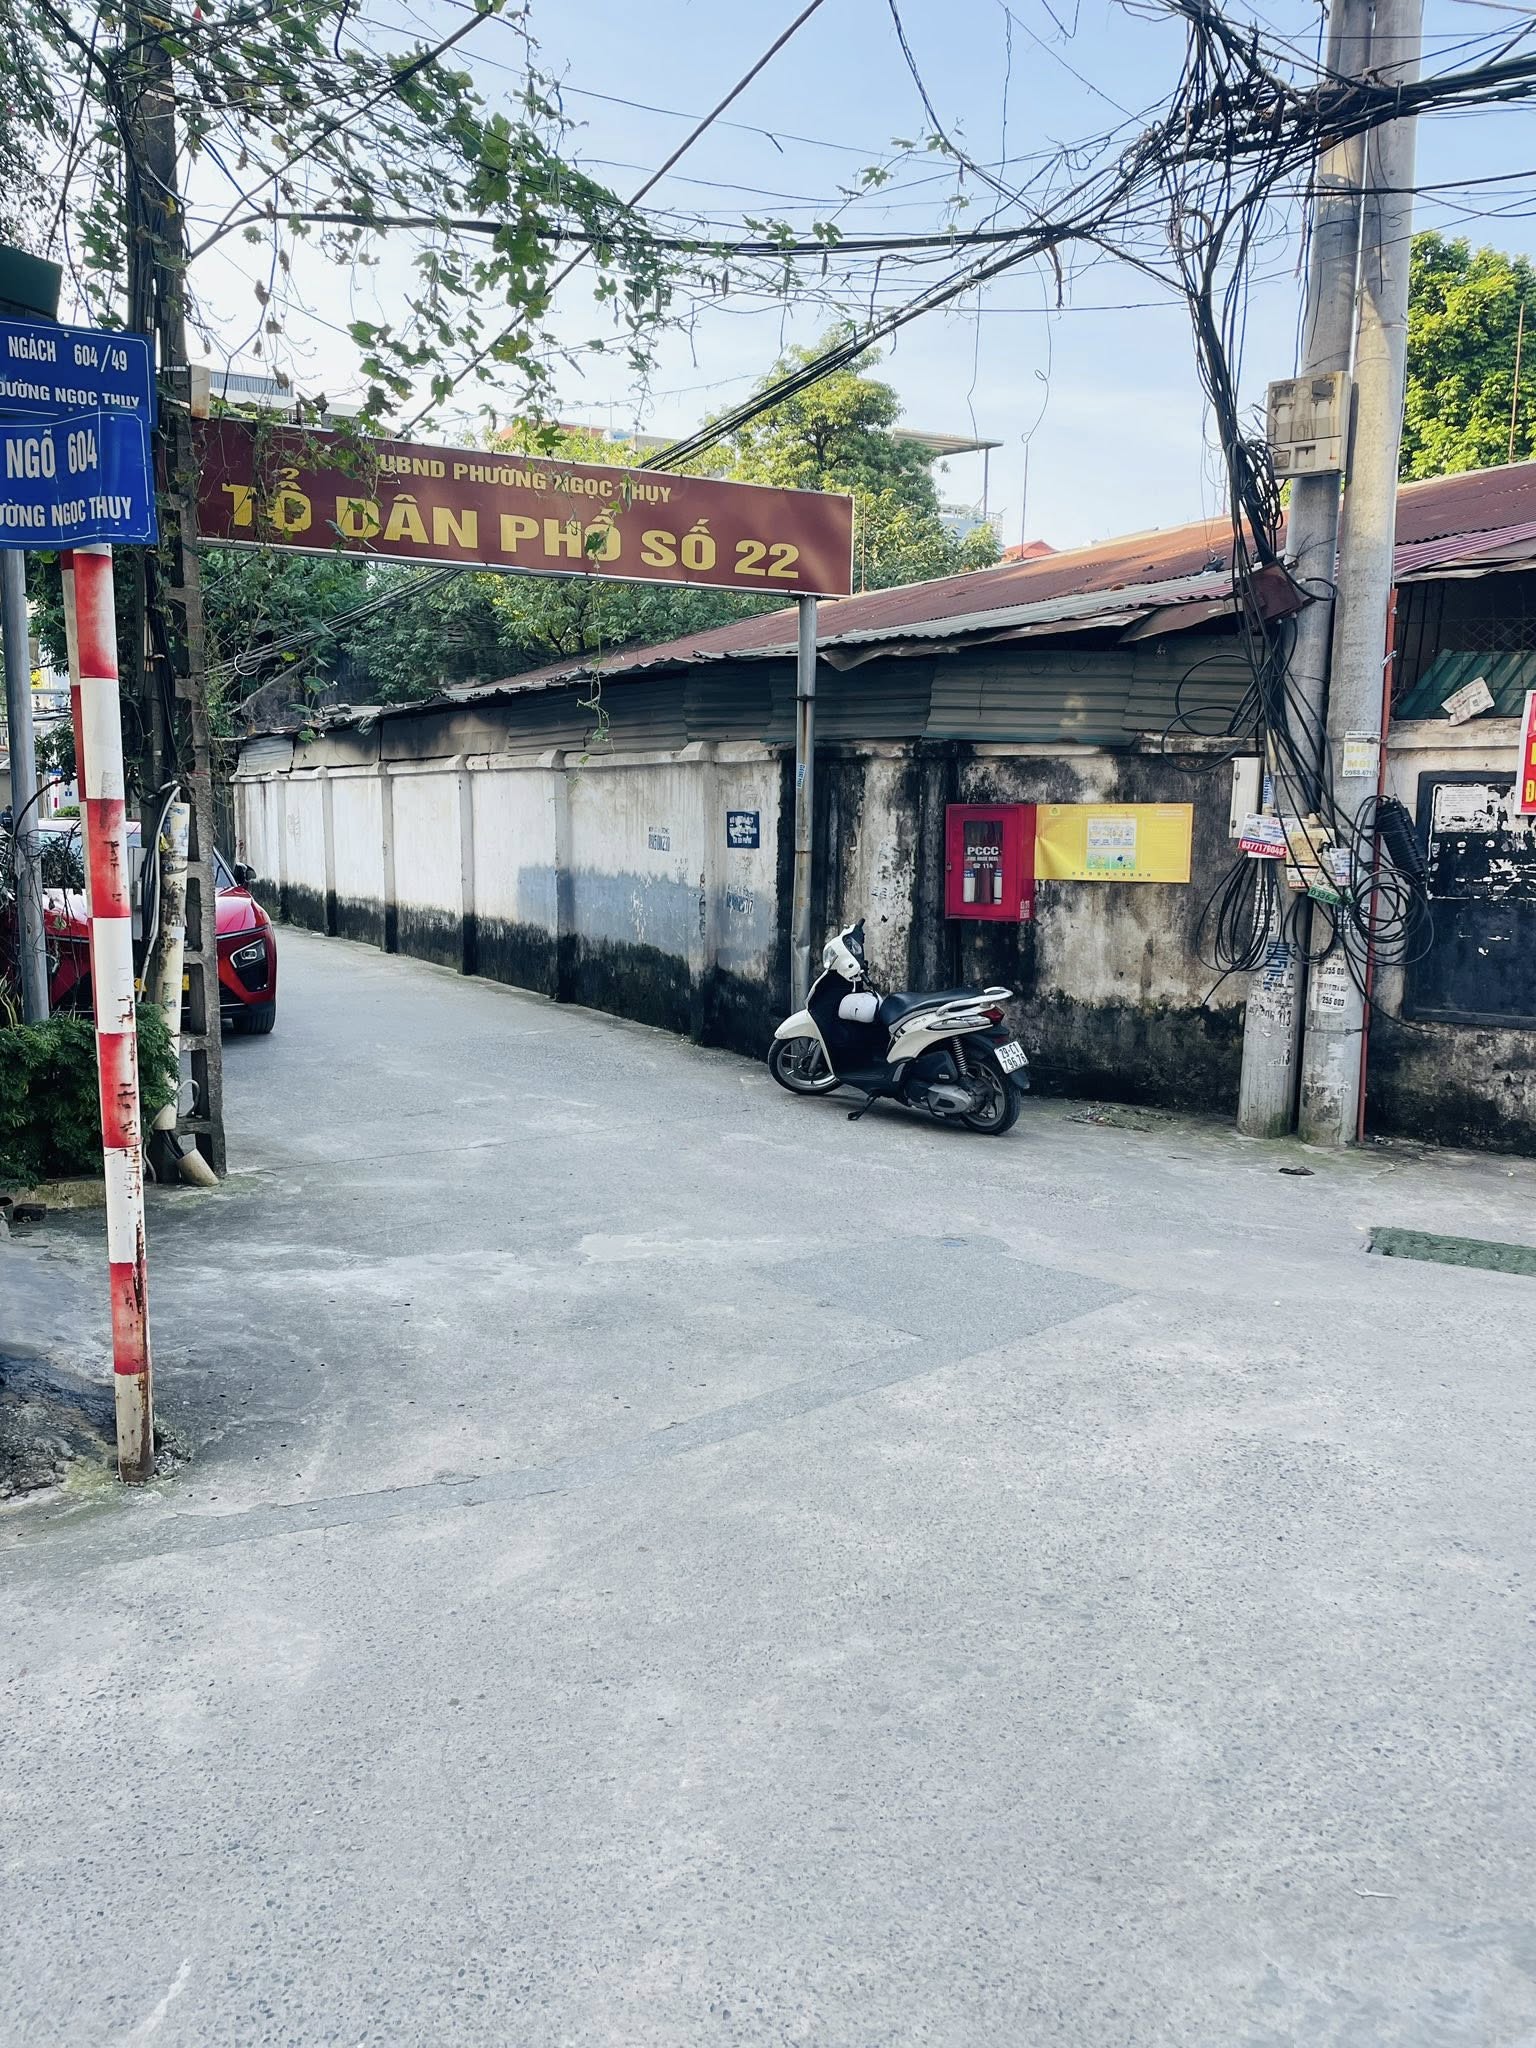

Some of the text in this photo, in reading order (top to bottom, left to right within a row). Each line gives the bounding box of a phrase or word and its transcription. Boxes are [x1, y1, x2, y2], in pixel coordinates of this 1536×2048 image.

[8, 333, 127, 373] NGÁCH 604/49
[55, 387, 98, 408] NGỌC
[6, 429, 97, 479] NGÕ 604
[379, 454, 445, 478] UBND
[454, 462, 547, 490] PHƯỜNG
[554, 475, 613, 499] NGỌC
[51, 500, 86, 530] NGỌC
[89, 496, 131, 526] THỤY
[336, 494, 478, 549] DÂN
[500, 508, 621, 562] PHỐ
[641, 518, 716, 571] SỐ
[734, 539, 799, 579] 22
[967, 846, 999, 856] PCCC
